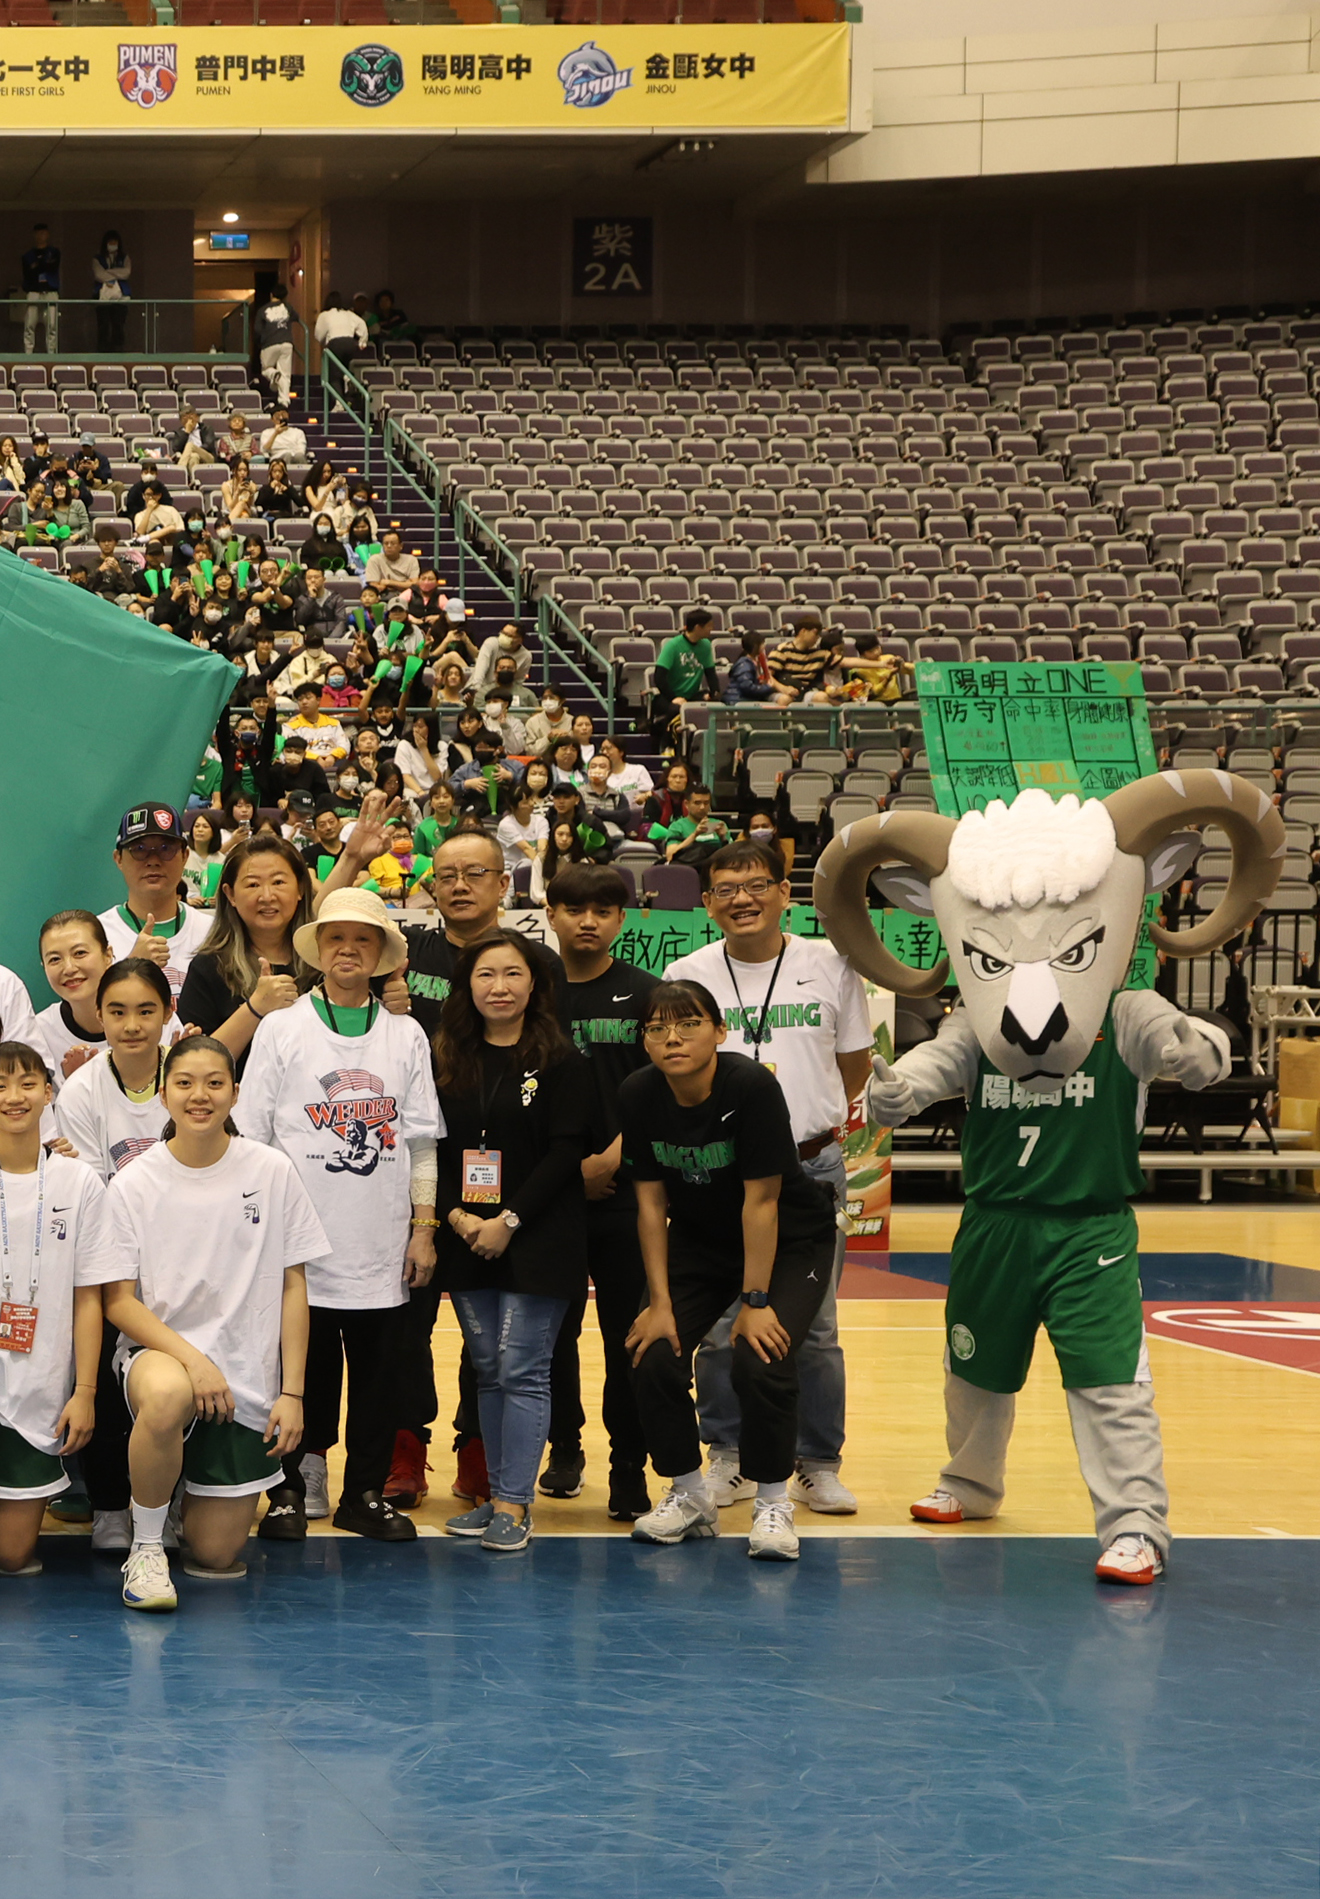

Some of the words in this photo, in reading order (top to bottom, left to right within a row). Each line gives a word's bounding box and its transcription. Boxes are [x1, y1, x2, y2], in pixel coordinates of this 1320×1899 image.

[118, 45, 176, 71] PUMEN
[195, 54, 306, 82] 普門中學
[422, 53, 532, 81] 陽明高中
[645, 52, 756, 80] 金甌女中
[11, 87, 35, 97] FIRST
[38, 87, 65, 97] GIRLS
[196, 86, 231, 96] PUMEN
[423, 85, 451, 95] YANG
[454, 85, 482, 95] MING
[645, 84, 677, 95] JINOU
[592, 223, 634, 257] 紫
[583, 262, 643, 290] 2A
[944, 699, 997, 723] 防守
[1003, 699, 1061, 723] 命中率
[759, 1002, 822, 1029] MING
[304, 1097, 398, 1130] WEIDER
[1018, 1125, 1041, 1167] 7
